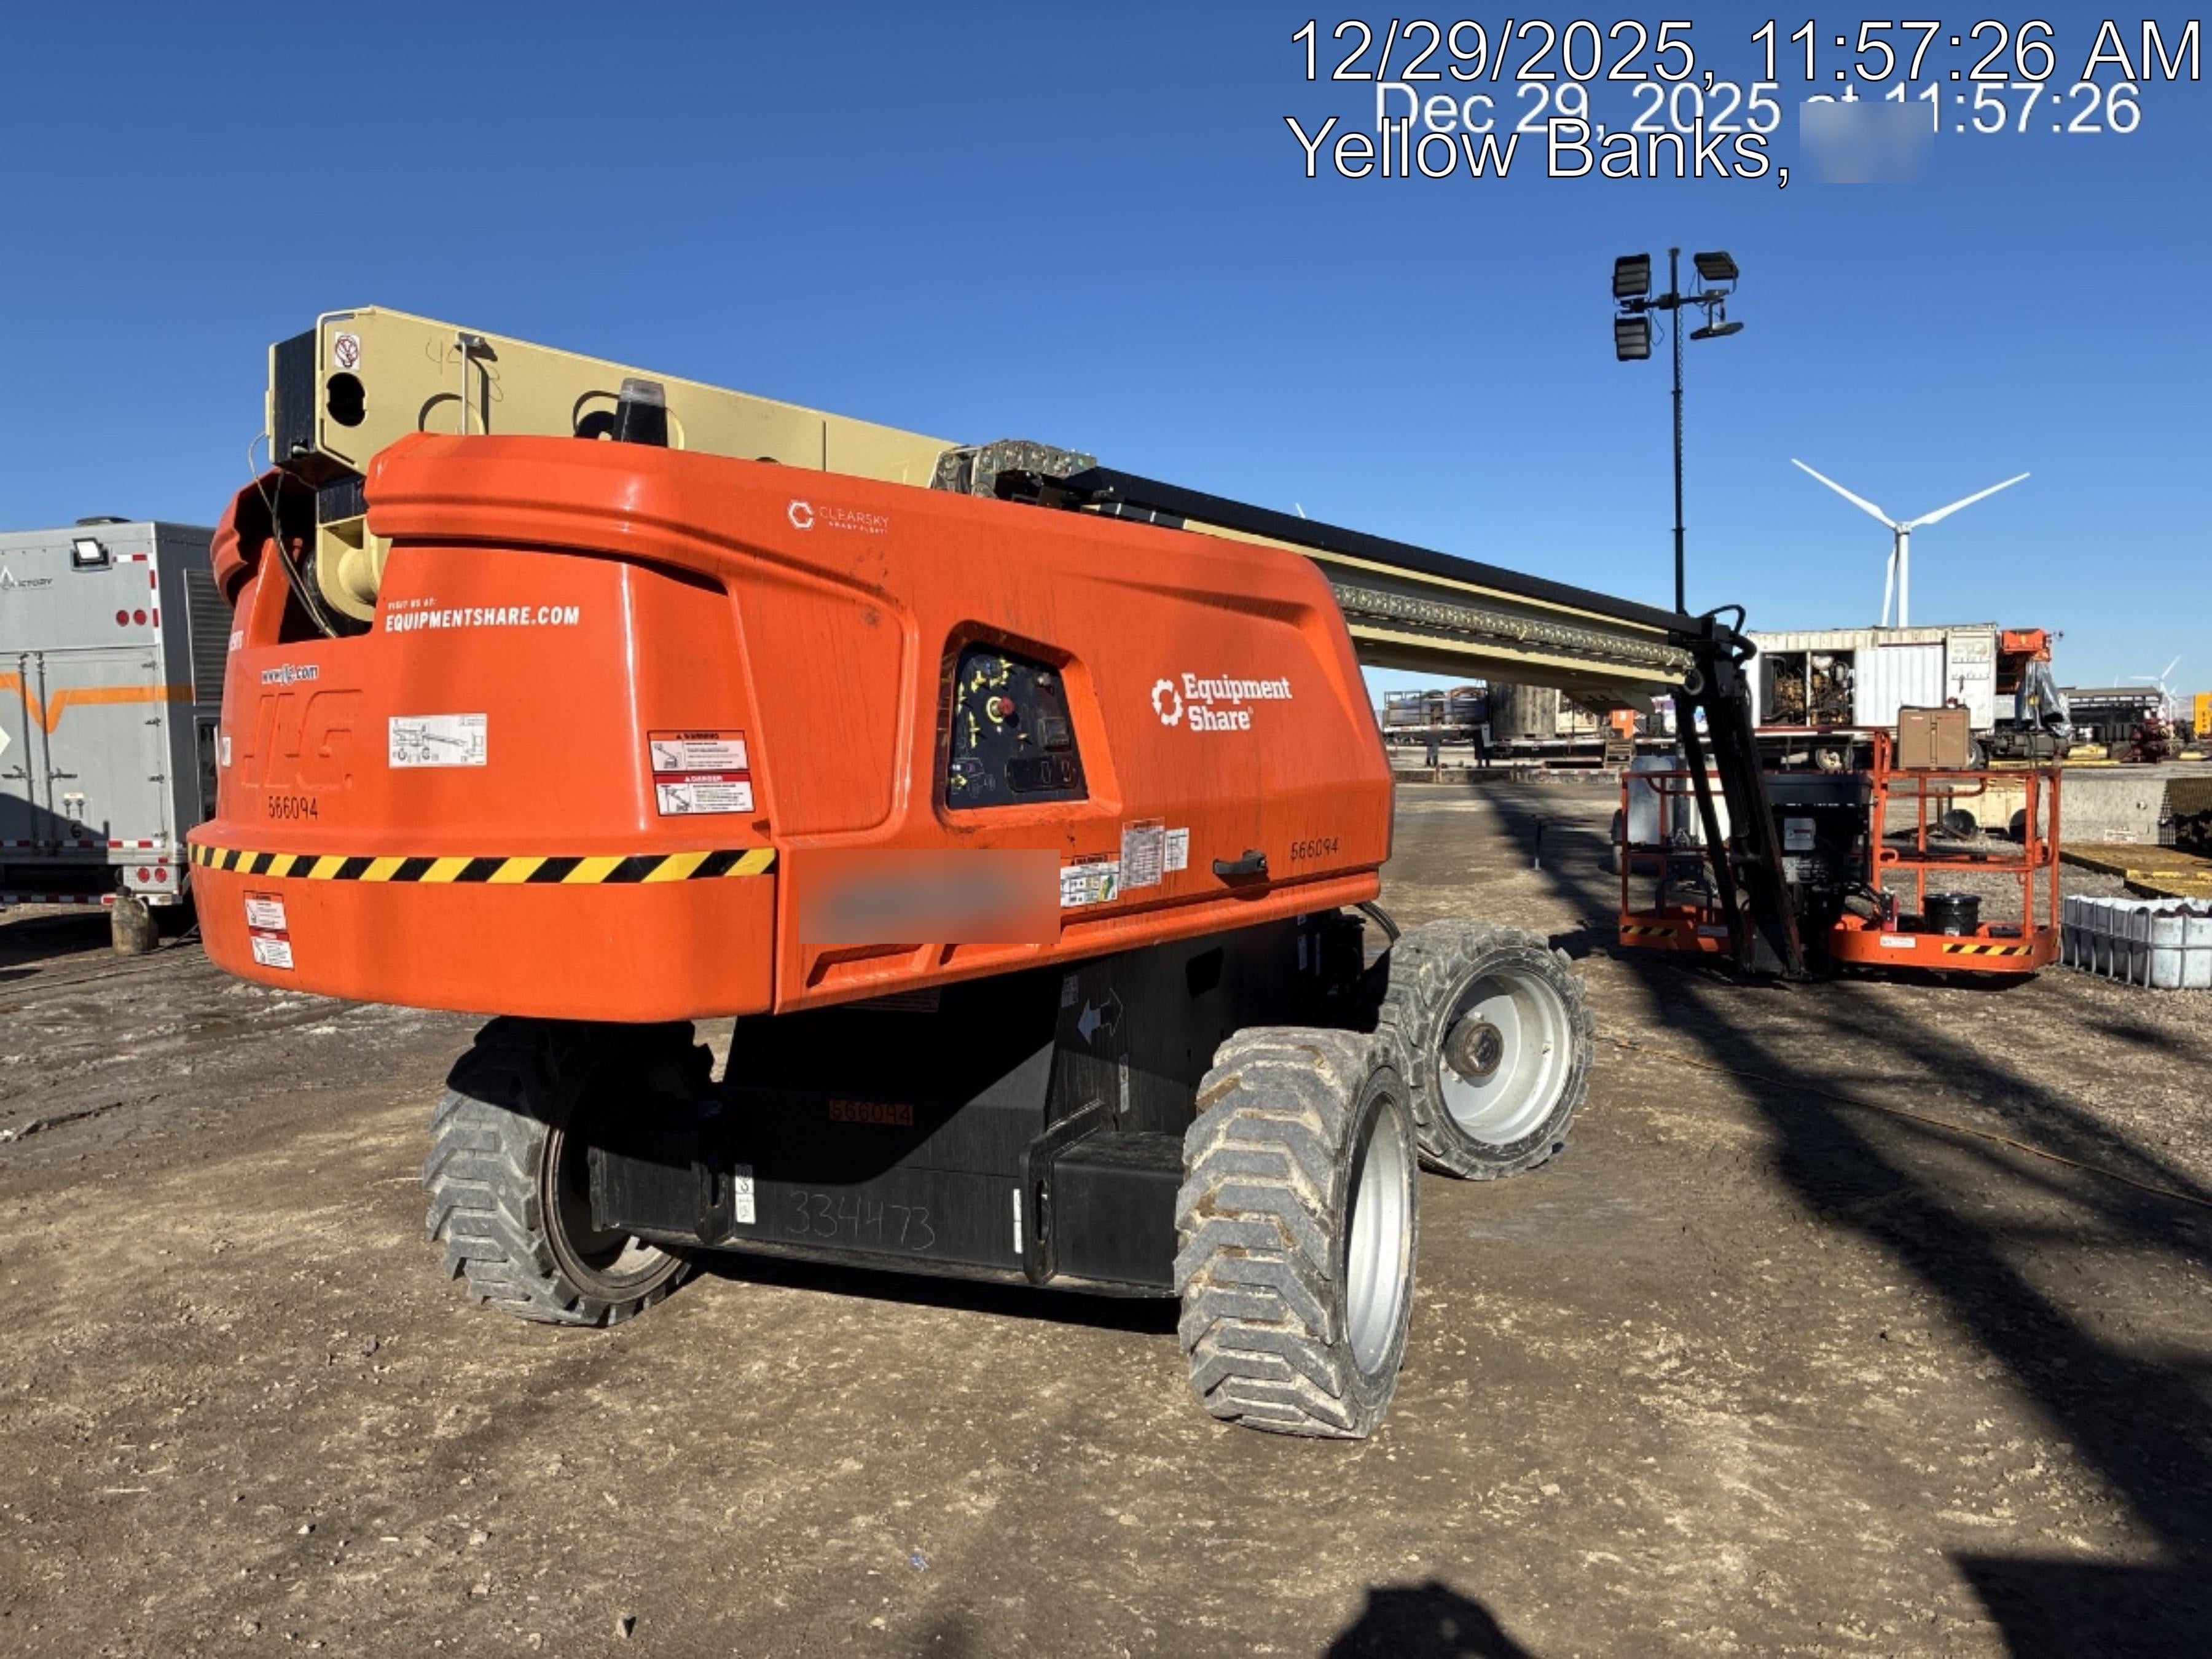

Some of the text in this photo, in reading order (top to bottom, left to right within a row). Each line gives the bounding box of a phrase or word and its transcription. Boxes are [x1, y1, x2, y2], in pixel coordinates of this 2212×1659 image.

[819, 506, 889, 527] CLEARSKY
[385, 606, 580, 632] EQUIPMENTSHARE.COM
[1182, 672, 1293, 705] Equipment
[269, 796, 319, 820] 566094
[1290, 837, 1338, 862] 566094
[831, 1100, 912, 1124] 566094
[786, 1190, 935, 1250] 334473
